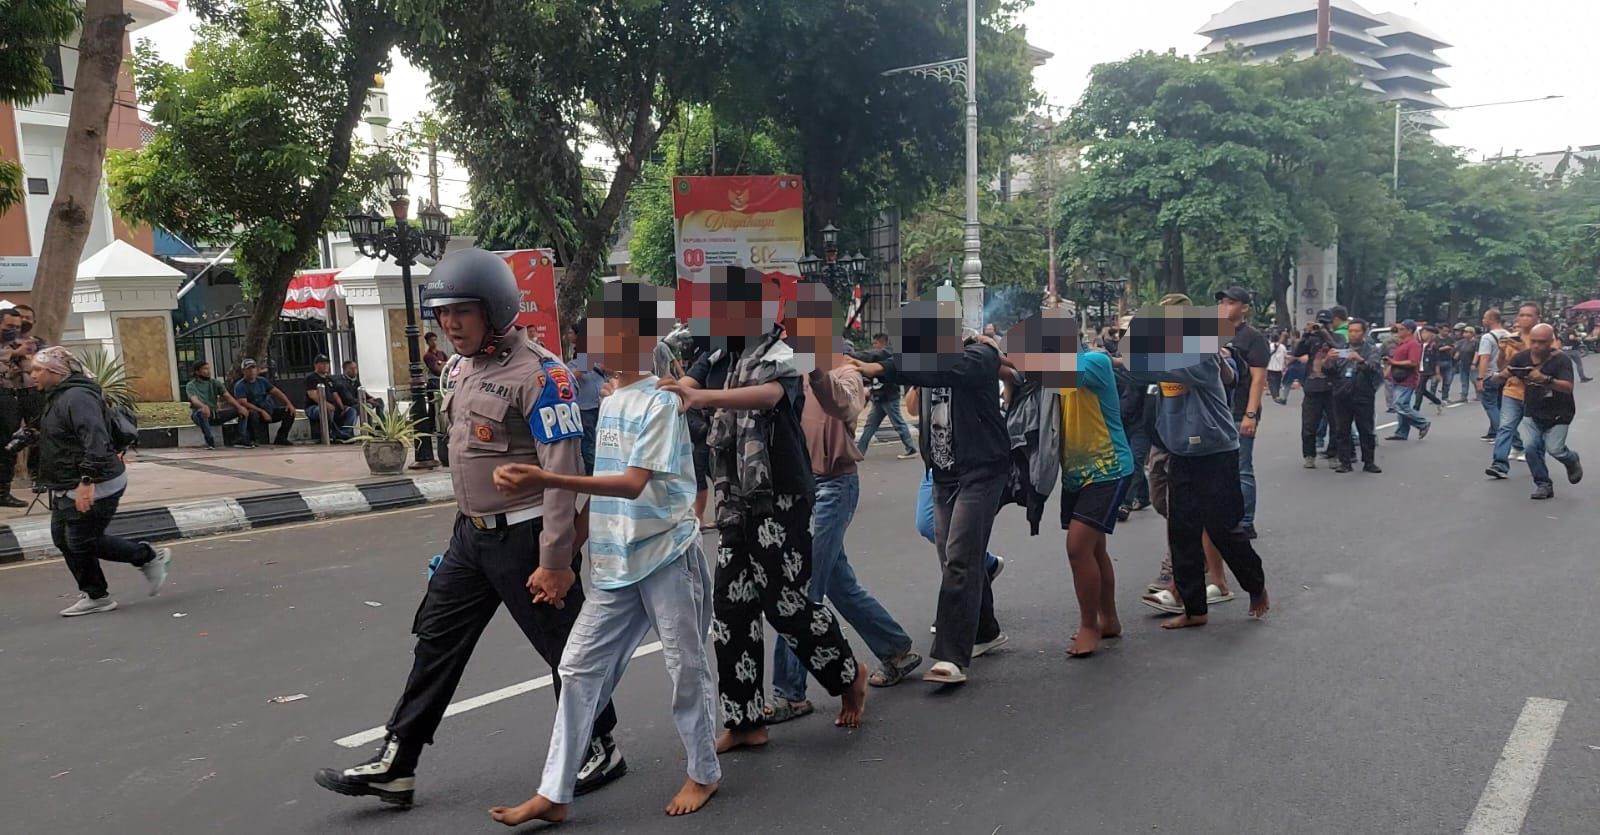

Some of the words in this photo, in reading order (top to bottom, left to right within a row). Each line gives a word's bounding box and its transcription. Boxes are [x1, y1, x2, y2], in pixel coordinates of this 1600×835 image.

[427, 279, 445, 289] mds
[479, 382, 509, 398] POLRI
[539, 402, 584, 439] PRO
